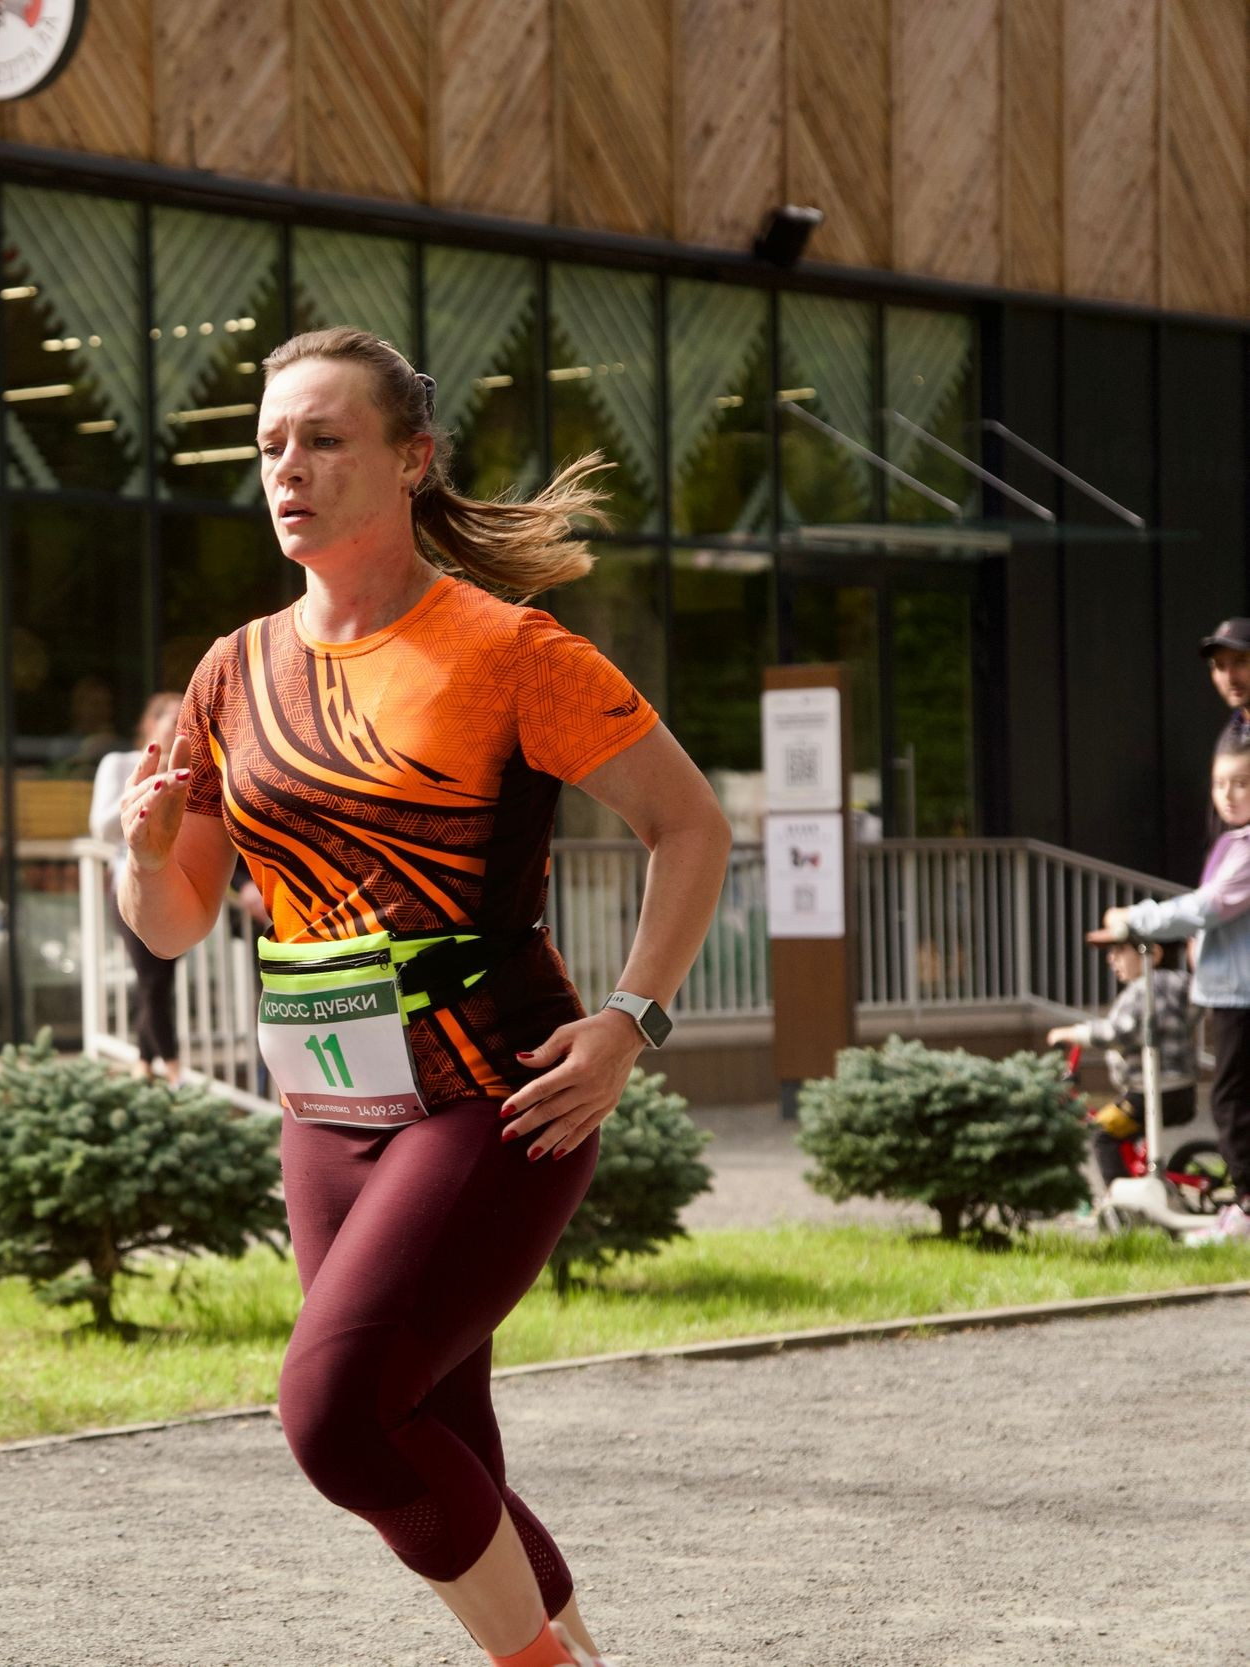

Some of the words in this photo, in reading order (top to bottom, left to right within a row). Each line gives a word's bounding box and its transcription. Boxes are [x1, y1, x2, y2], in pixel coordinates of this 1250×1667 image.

[264, 1001, 309, 1018] КРОСС
[313, 993, 377, 1020] ДУБКИ
[304, 1033, 354, 1088] 11
[303, 1101, 350, 1114] Апрелевка
[356, 1103, 406, 1117] 14.09.25
